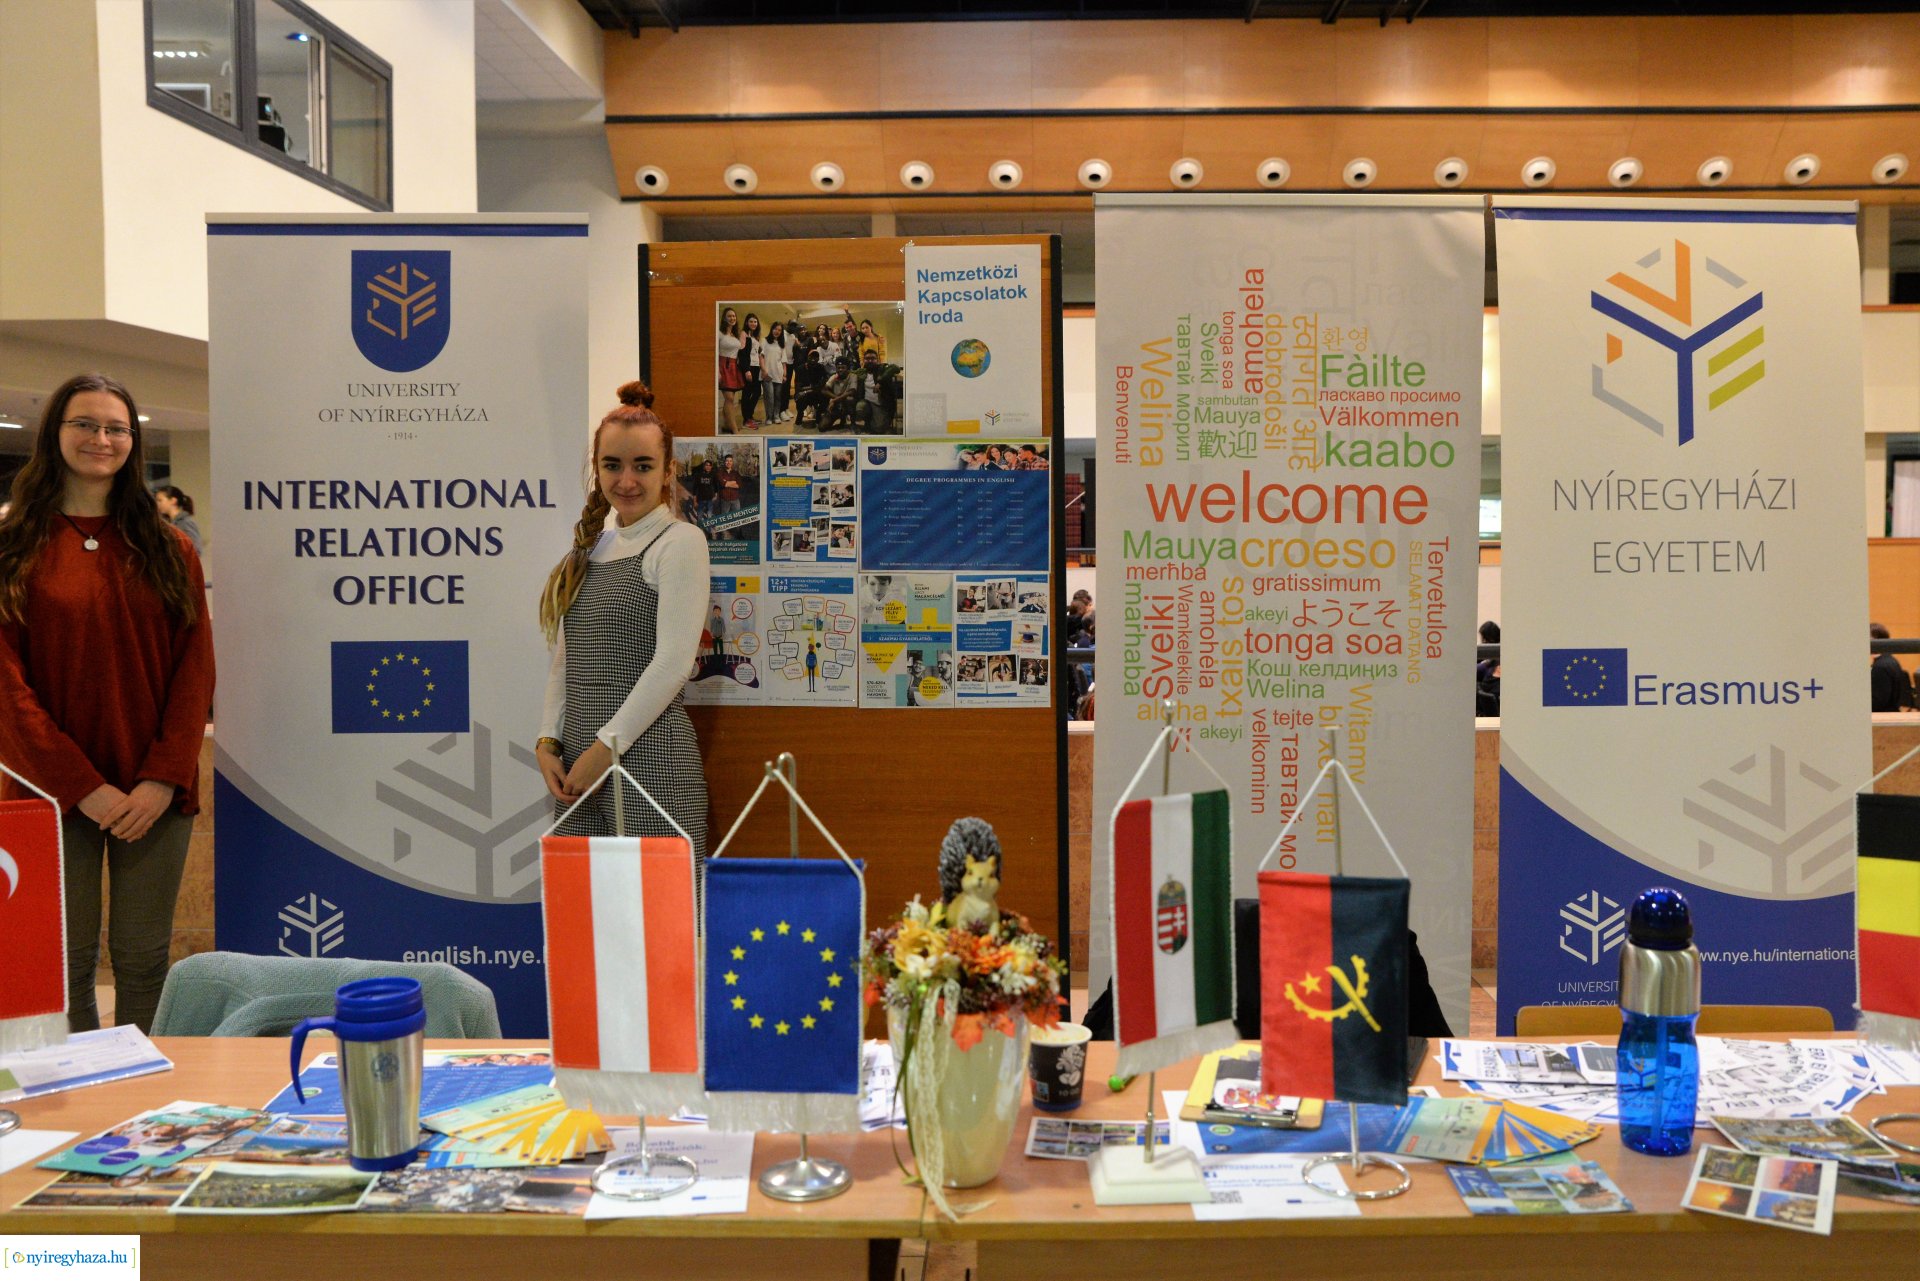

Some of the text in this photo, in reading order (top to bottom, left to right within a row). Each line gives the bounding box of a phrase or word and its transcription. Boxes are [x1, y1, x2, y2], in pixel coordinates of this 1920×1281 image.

[916, 264, 1018, 284] Nemzetközi
[917, 285, 1028, 307] Kapcsolatok
[918, 309, 964, 326] Iroda
[1239, 268, 1265, 394] amohela
[1199, 322, 1219, 385] Sveiki
[1219, 311, 1236, 390] tonga soa
[1172, 313, 1196, 461] тавтай морил
[1263, 312, 1288, 451] dobrodošli
[1321, 353, 1426, 389] Fàilte
[347, 383, 461, 398] UNIVERSITY
[1139, 336, 1173, 467] Welina
[1197, 394, 1259, 406] sambutan
[1319, 389, 1461, 404] ласкаво просимо
[318, 405, 491, 423] OF NYÍREGYHÁZA
[1115, 366, 1134, 464] Benvenuti
[1194, 406, 1261, 429] Mauya
[1319, 405, 1460, 428] Välkommen
[1325, 430, 1455, 469] kaabo
[243, 478, 557, 510] INTERNATIONAL
[1145, 470, 1428, 525] welcome
[1554, 469, 1796, 511] NYÍREGYHÁZI
[294, 526, 504, 557] RELATIONS
[1123, 529, 1396, 569] Mauya croeso
[1592, 540, 1766, 574] EGYETEM
[770, 578, 788, 586] 12+1
[1126, 561, 1207, 581] merħba
[1252, 573, 1382, 596] gratissimum
[333, 574, 465, 605] OFFICE
[1426, 535, 1450, 660] Tervetuloa
[1245, 606, 1289, 625] akeyi
[1292, 598, 1402, 629] ようこそ
[1406, 540, 1423, 685] SELAMAT DATANG
[1123, 582, 1146, 696] marhaba
[1142, 595, 1175, 699] Sveiki
[1177, 584, 1194, 695] Wamkelekile
[1199, 590, 1219, 689] amohela
[1215, 576, 1245, 717] txais tos
[1244, 627, 1403, 661] tonga soa
[1247, 658, 1291, 678] Кош
[1247, 678, 1325, 699] Welina
[1634, 674, 1825, 707] Erasmus+
[1200, 725, 1243, 742] akeyi
[1272, 709, 1314, 730] tejte
[1251, 708, 1271, 814] velkominn
[403, 946, 546, 969] english.nye.
